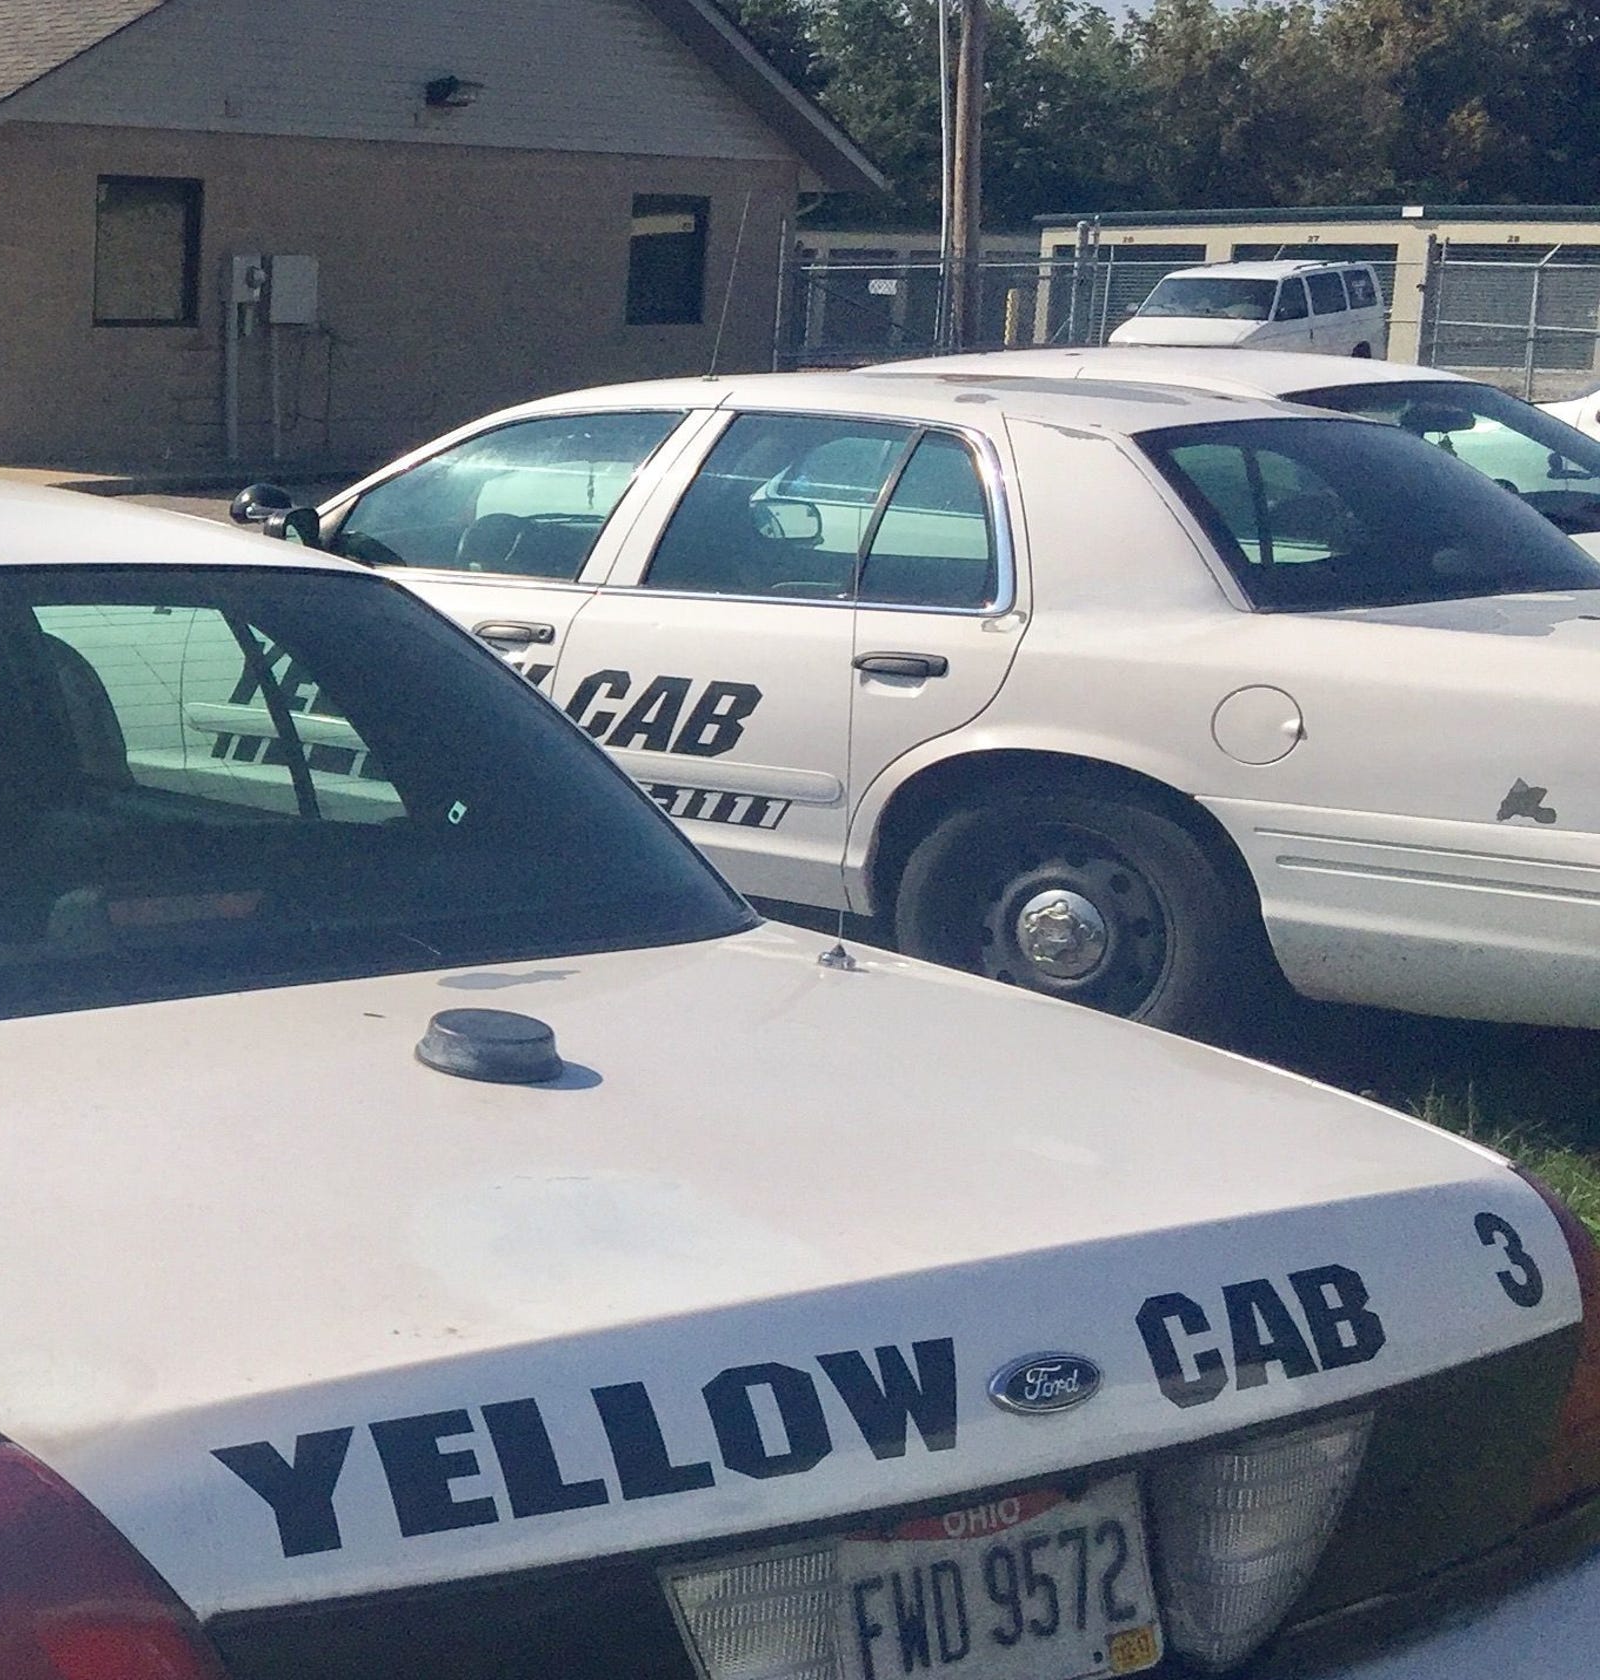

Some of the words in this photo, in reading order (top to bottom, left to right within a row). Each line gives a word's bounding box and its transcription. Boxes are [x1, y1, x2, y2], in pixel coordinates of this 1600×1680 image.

[564, 669, 763, 757] CAB
[636, 782, 788, 828] -1111
[1473, 1211, 1543, 1307] 3
[1135, 1263, 1386, 1408] CAB
[1025, 1365, 1079, 1400] Ford
[211, 1337, 957, 1557] YELLOW
[942, 1498, 1021, 1538] OHIO
[852, 1558, 971, 1680] FWD
[979, 1519, 1138, 1647] 9572
